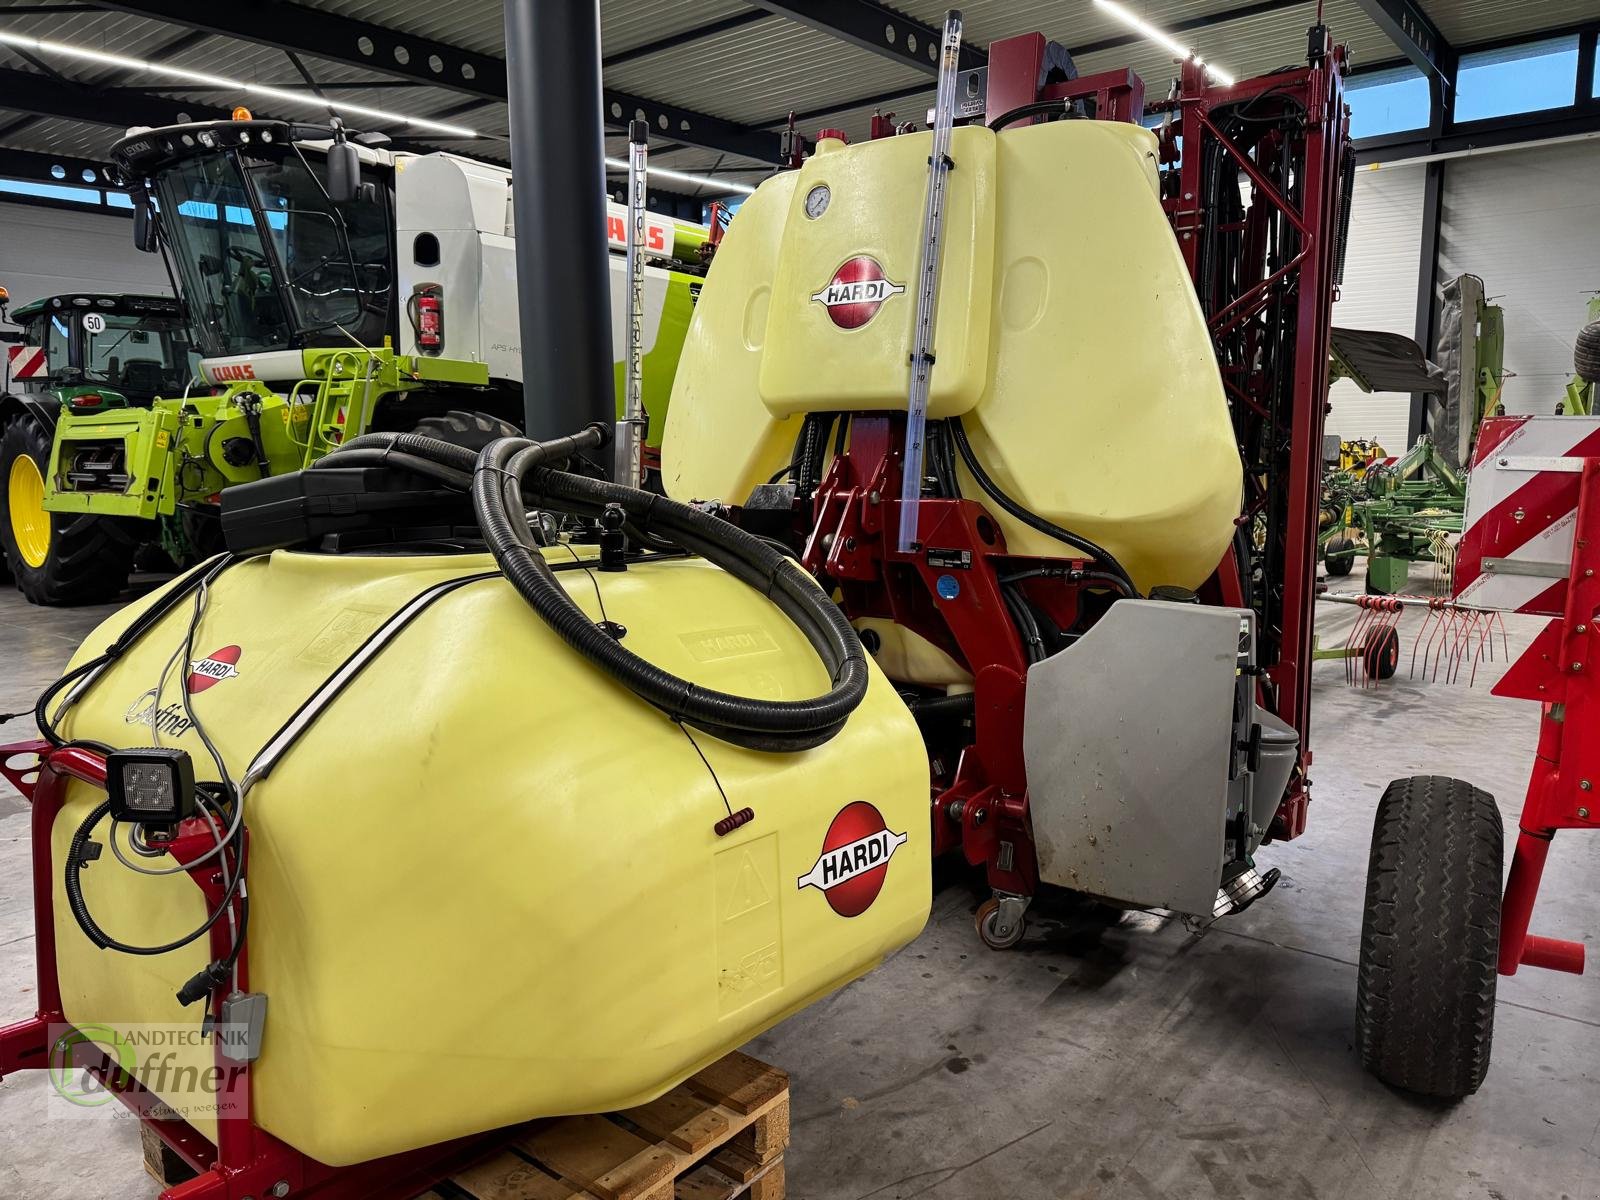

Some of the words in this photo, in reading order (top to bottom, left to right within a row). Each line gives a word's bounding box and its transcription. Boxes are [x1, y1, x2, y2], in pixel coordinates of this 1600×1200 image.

[827, 283, 885, 304] HARDI
[87, 316, 101, 330] 50
[212, 365, 256, 381] CLAAS
[196, 660, 231, 678] HARDI
[822, 834, 889, 885] HARDI
